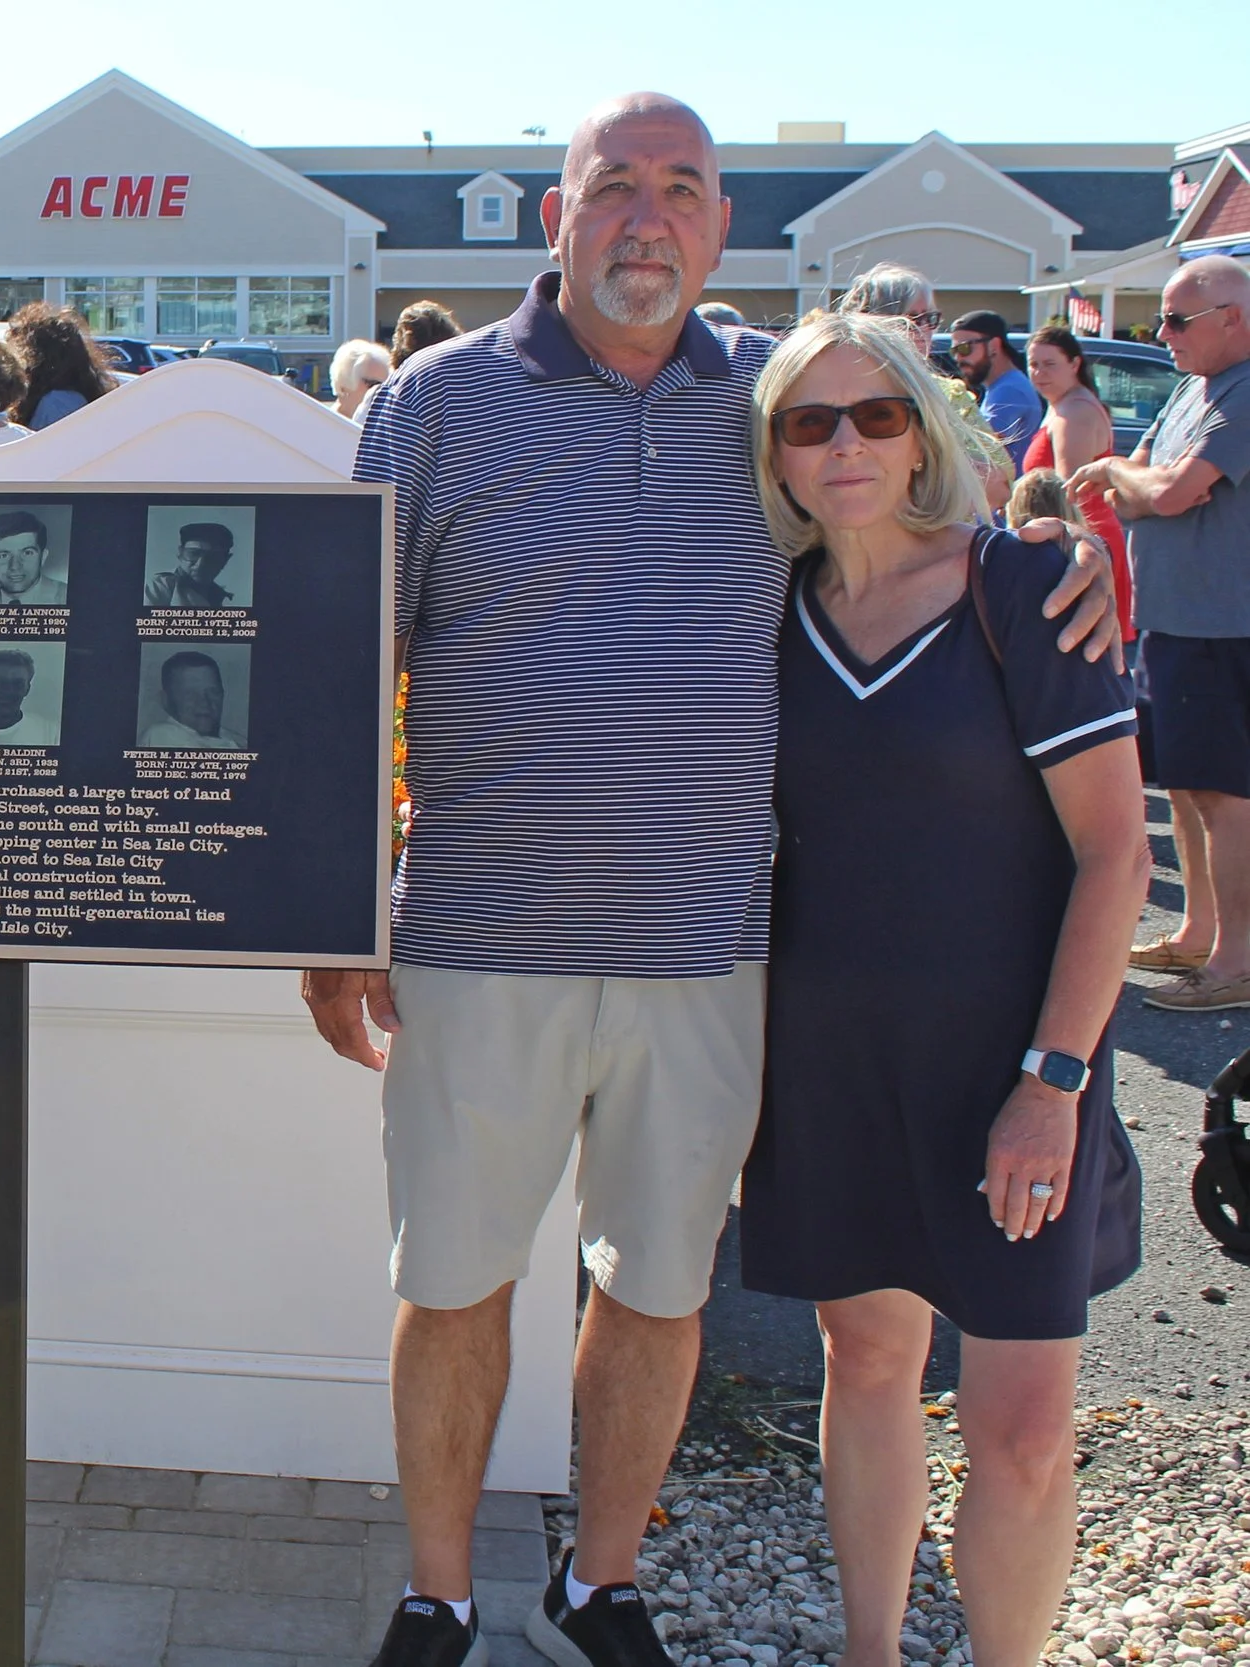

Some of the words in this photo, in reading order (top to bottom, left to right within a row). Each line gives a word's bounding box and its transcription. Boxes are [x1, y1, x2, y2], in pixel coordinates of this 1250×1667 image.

[39, 174, 191, 219] ACME
[196, 610, 246, 618] BOLOGNO
[21, 617, 40, 626] 1ST,
[136, 618, 168, 626] BORN:
[205, 619, 232, 628] 19TH,
[14, 627, 40, 635] 10TH,
[165, 628, 213, 636] OCTOBER
[217, 629, 230, 637] 12,
[3, 749, 46, 757] BALDINI
[123, 751, 157, 759] PETER
[174, 752, 258, 760] KARANOZINSKY
[10, 758, 32, 767] 3RD,
[36, 759, 58, 767] 1933
[135, 760, 167, 768] BORN:
[170, 761, 197, 769] JULY
[199, 762, 222, 770] 4TH,
[5, 768, 31, 776] 21ST,
[136, 770, 162, 778] DIED
[165, 771, 188, 779] DEC.
[191, 771, 219, 780] 30TH,
[223, 772, 246, 780] 1976
[69, 788, 79, 798] a
[83, 786, 125, 801] large
[130, 787, 169, 799] tract
[174, 788, 191, 800] of
[194, 788, 231, 800] land
[54, 805, 100, 815] ocean
[105, 803, 121, 815] to
[126, 804, 158, 819] bay.
[19, 819, 64, 831] south
[69, 820, 99, 832] end
[104, 820, 141, 833] with
[145, 822, 190, 834] small
[195, 823, 267, 838] cottages.
[46, 837, 97, 849] center
[101, 837, 118, 849] in
[123, 837, 151, 850] Sea
[155, 838, 185, 851] Isle
[190, 839, 227, 855] City.
[43, 853, 59, 865] to
[63, 853, 92, 866] Sea
[96, 854, 125, 867] Isle
[130, 855, 164, 871] City
[13, 871, 116, 884] construction
[121, 872, 166, 885] team.
[34, 888, 65, 900] and
[69, 889, 123, 901] settled
[128, 889, 145, 902] in
[150, 890, 196, 903] town.
[5, 904, 31, 916] the
[36, 905, 191, 921] multi-generational
[195, 909, 225, 922] ties
[0, 921, 29, 934] Isle
[34, 922, 72, 938] City.
